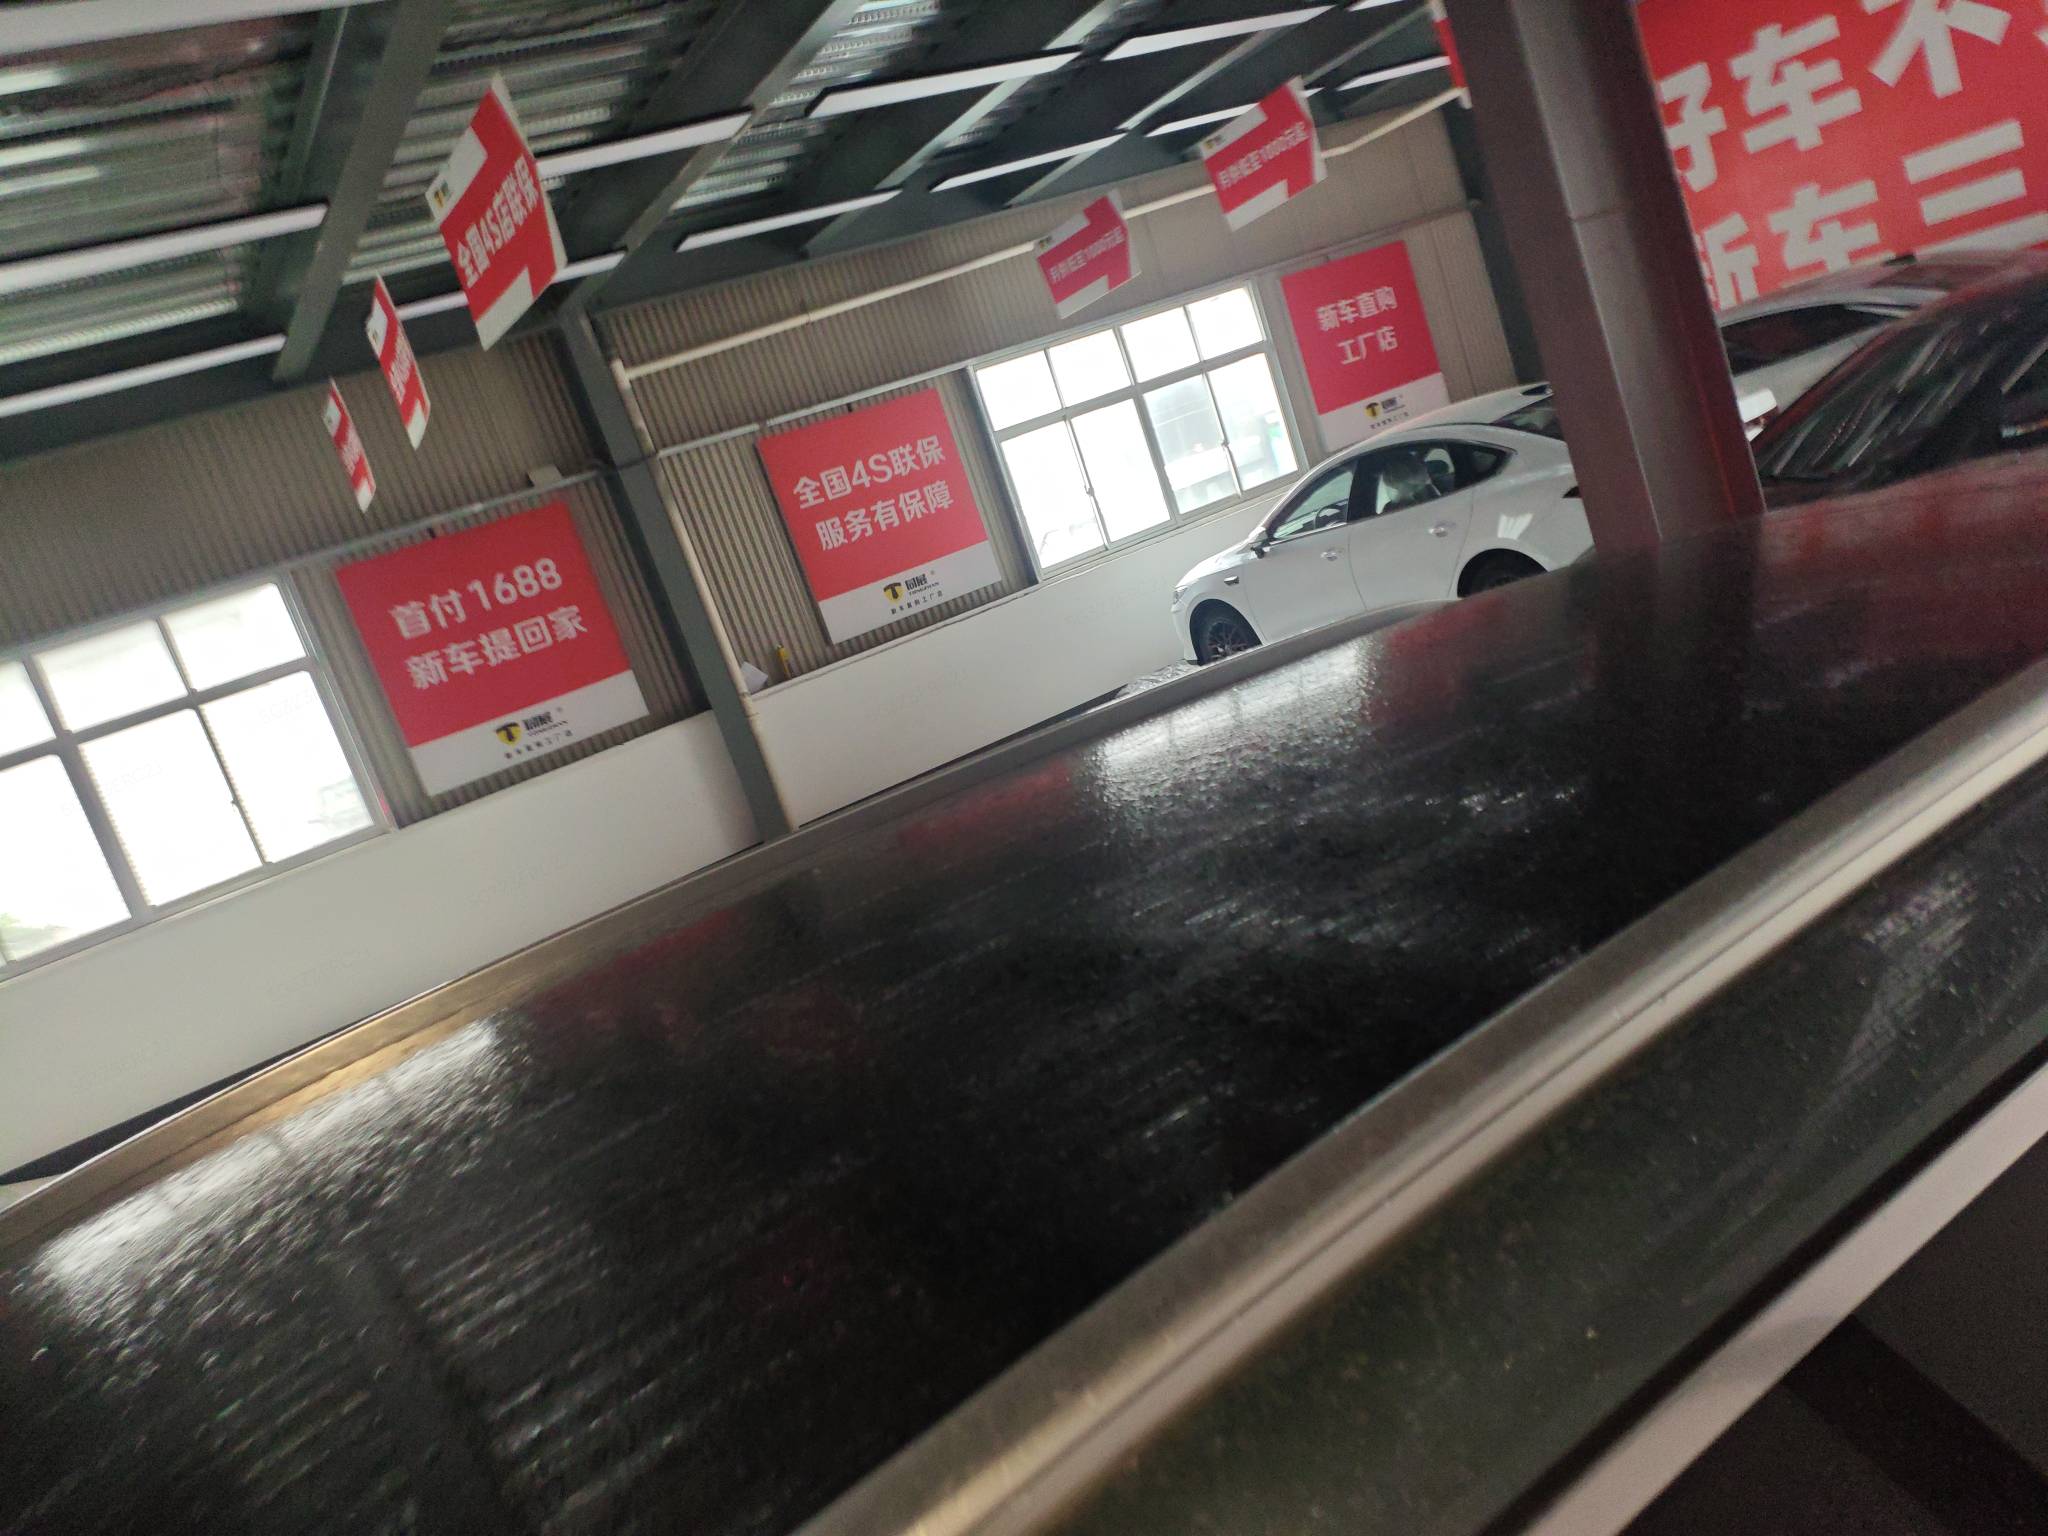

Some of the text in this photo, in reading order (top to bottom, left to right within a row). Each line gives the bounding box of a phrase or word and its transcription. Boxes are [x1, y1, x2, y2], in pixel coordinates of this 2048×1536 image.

[456, 154, 539, 290] 全国4S店联保
[1315, 286, 1398, 332] 新车直购
[1337, 325, 1399, 365] 工厂店
[792, 434, 946, 510] 全国4S联保
[815, 480, 954, 551] 服务有保障
[389, 558, 562, 640] 首付1688
[404, 605, 588, 690] 新车提回家
